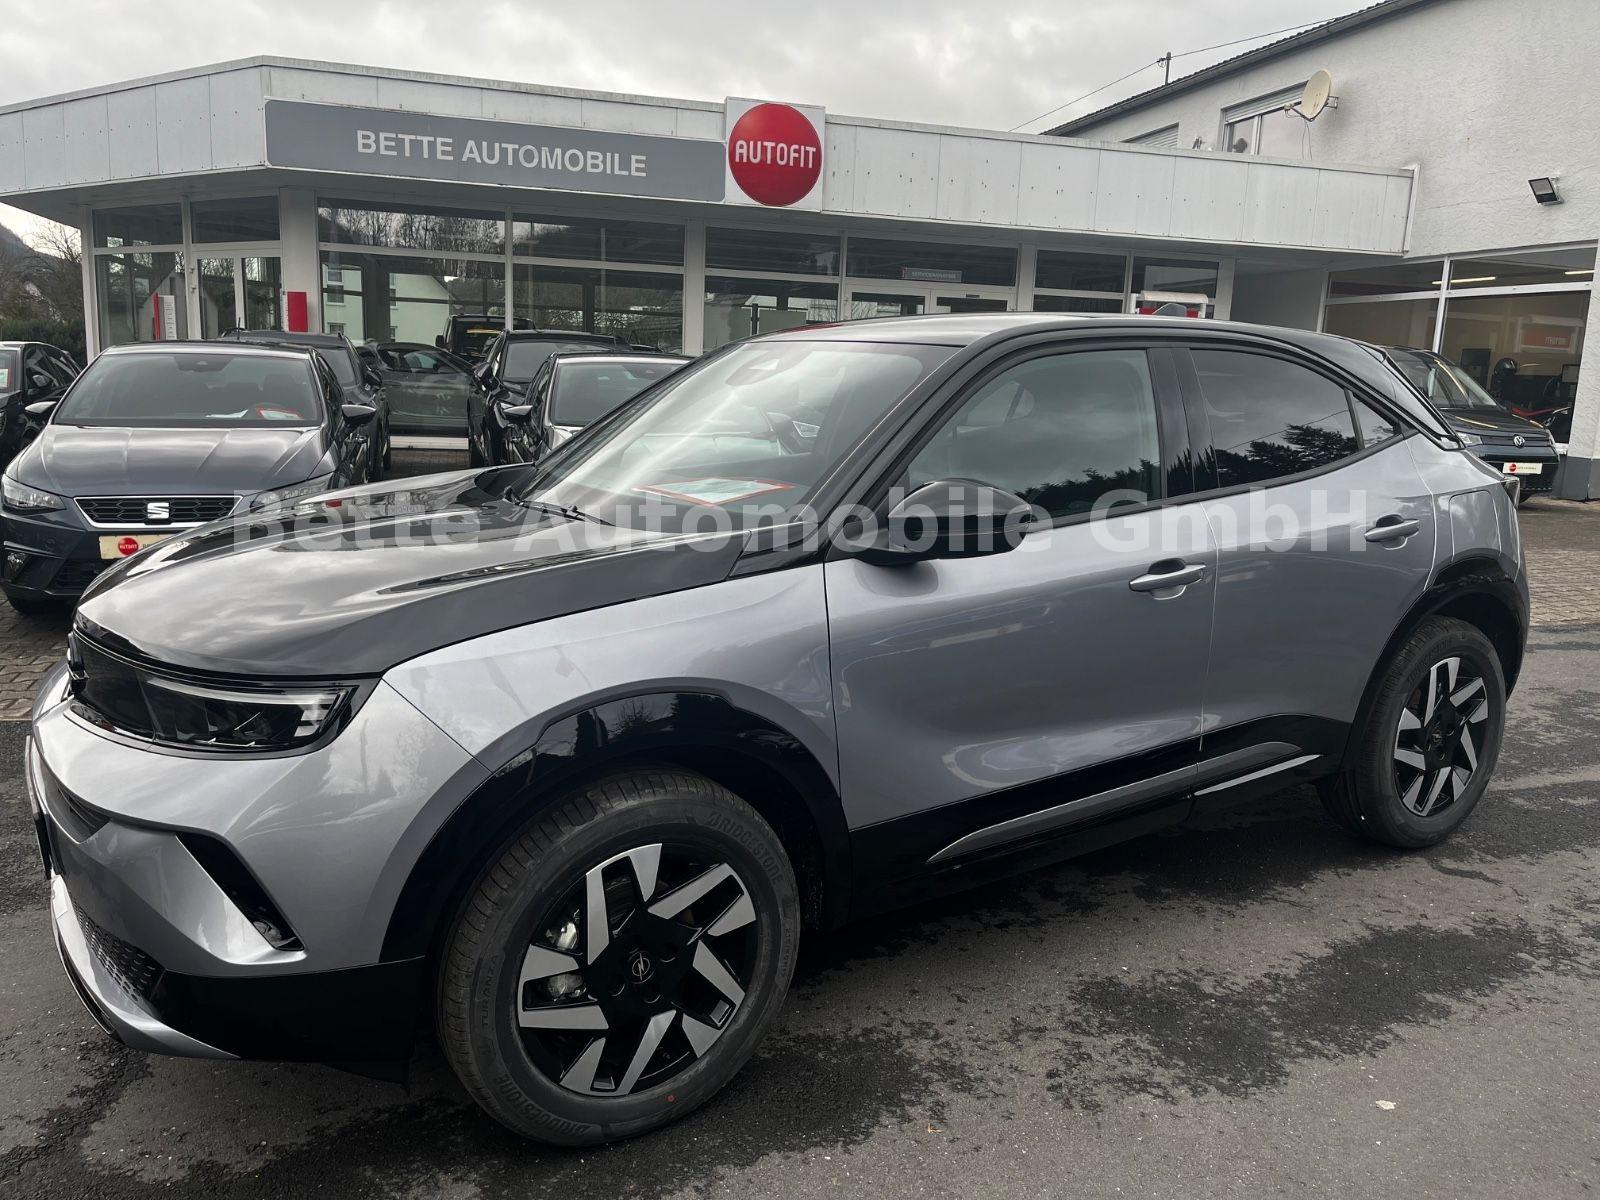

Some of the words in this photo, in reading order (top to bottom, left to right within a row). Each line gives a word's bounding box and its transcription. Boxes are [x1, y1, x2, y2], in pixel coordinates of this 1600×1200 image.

[356, 130, 454, 161] BETTE
[461, 139, 647, 177] AUTOMOBILE
[735, 139, 816, 169] AUTOFIT
[705, 810, 783, 886] BRIDGESTONE
[480, 954, 499, 1027] TURANZA
